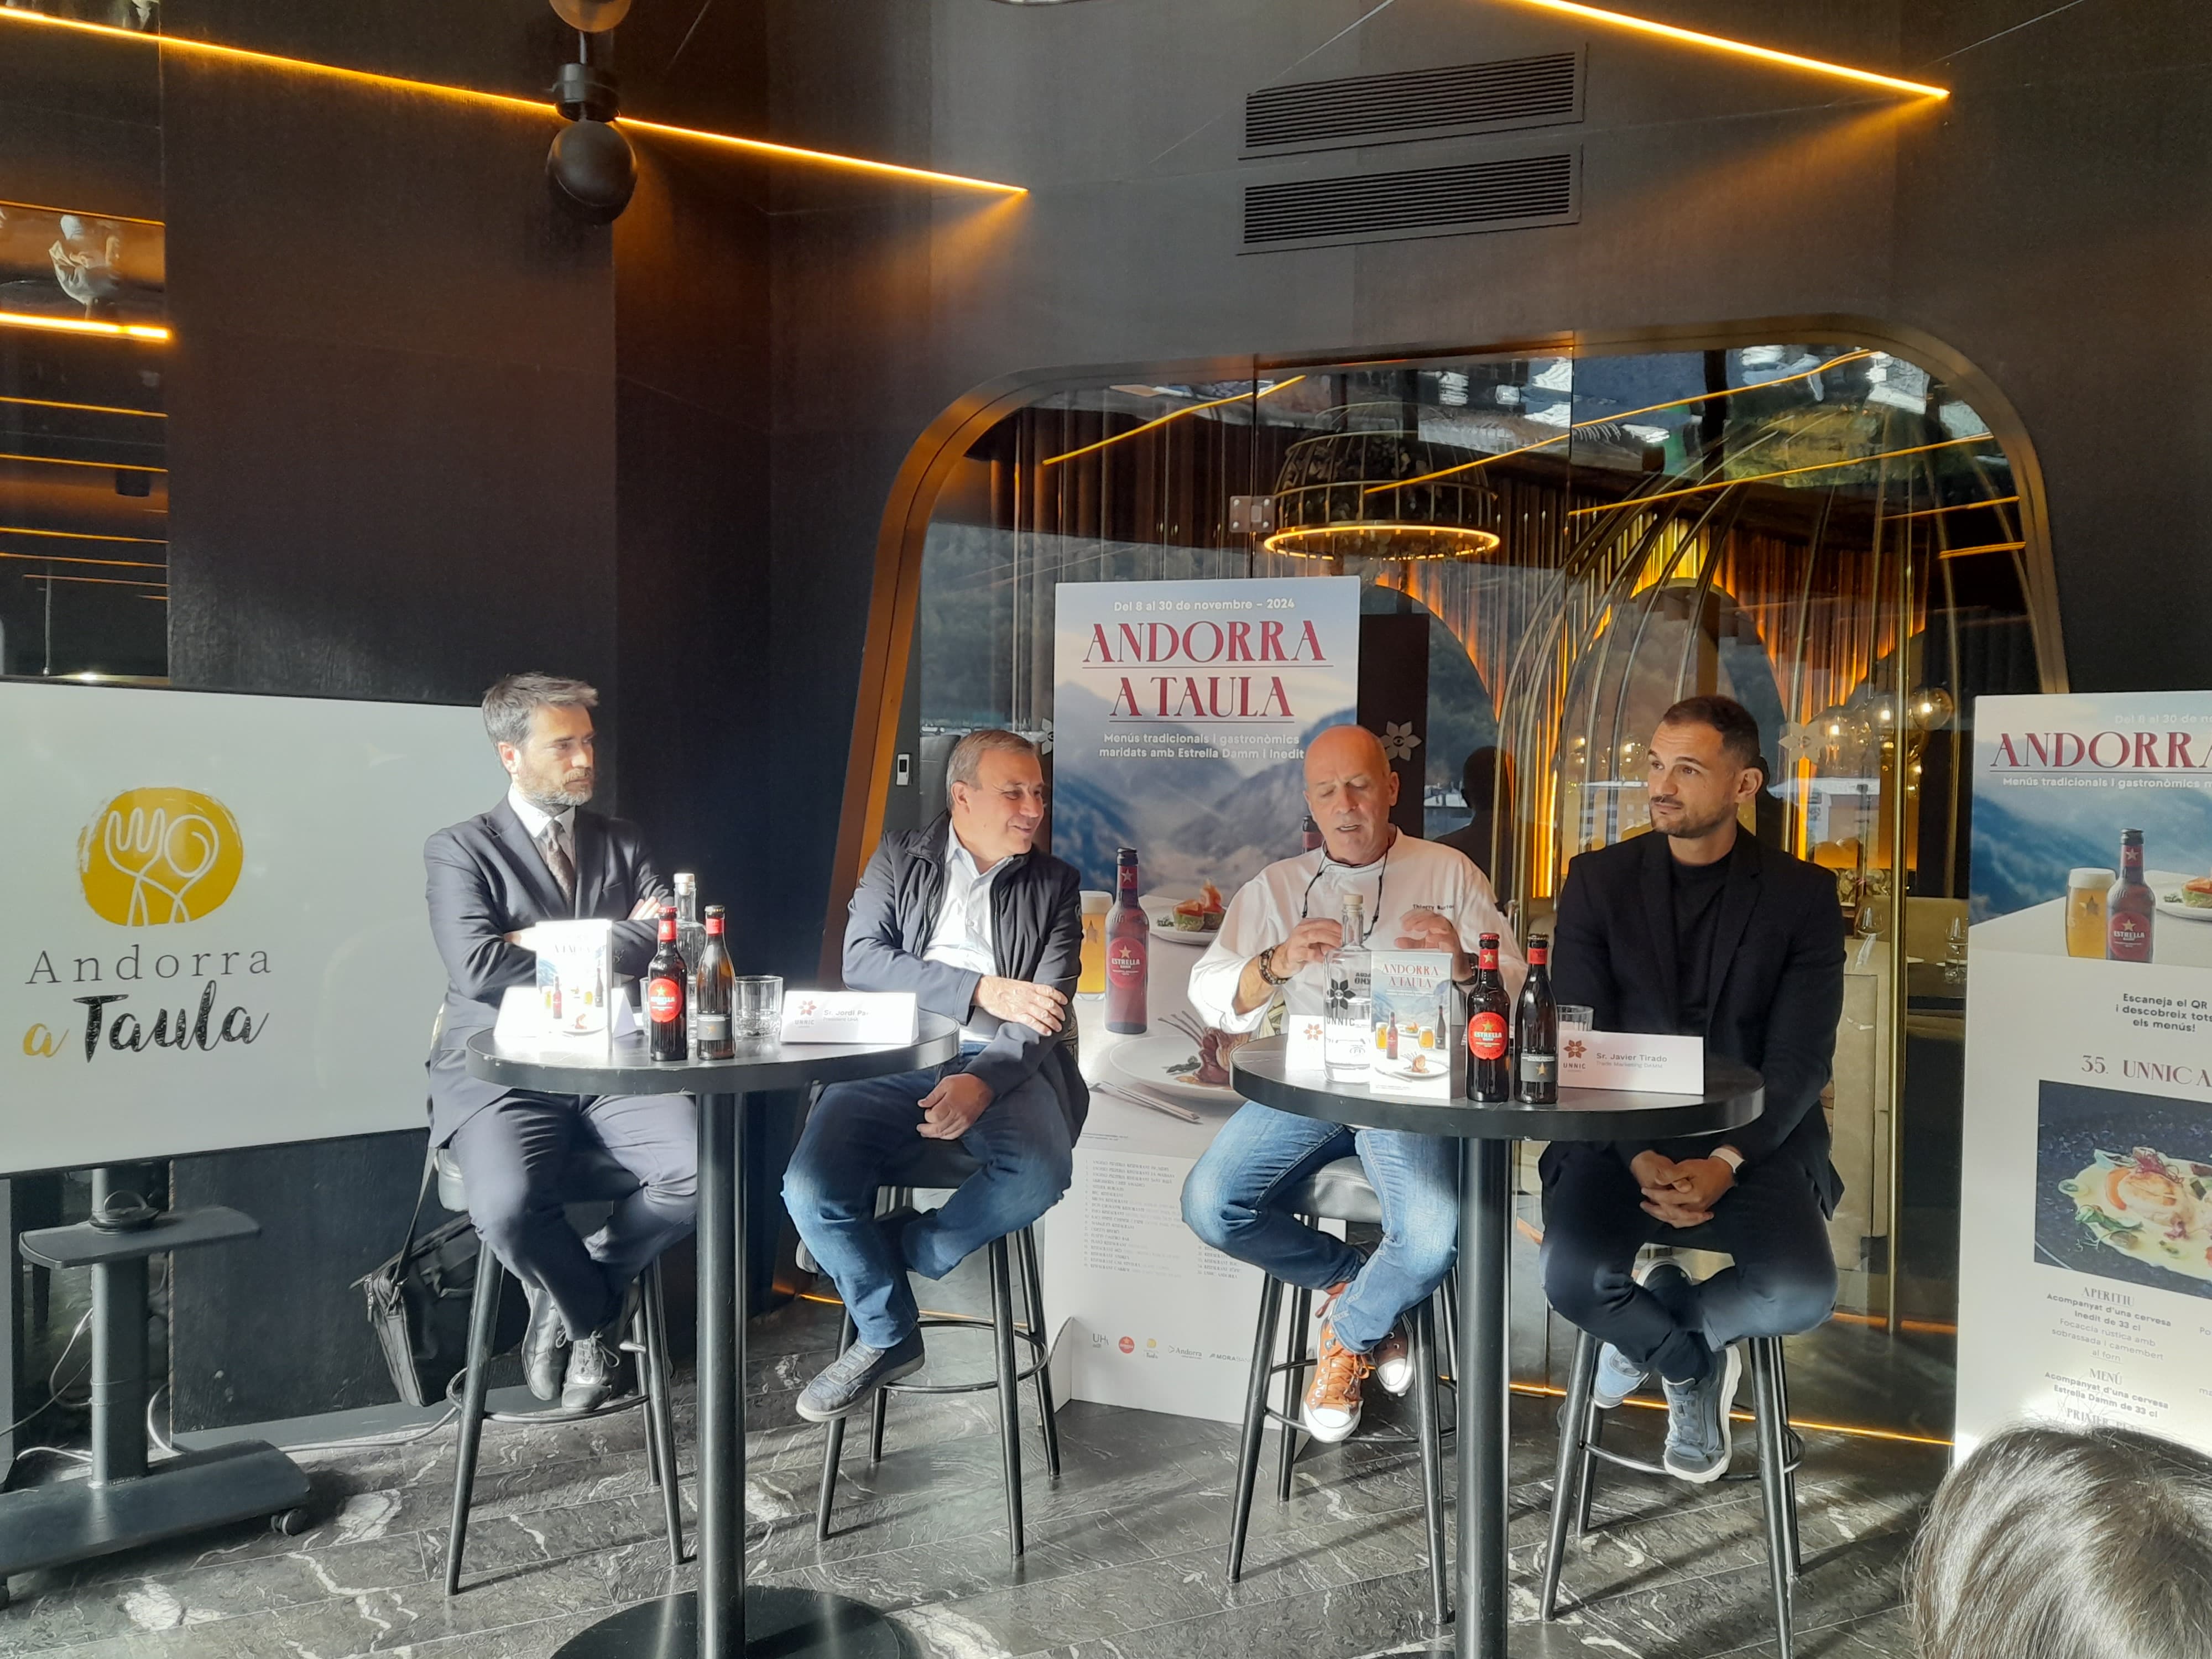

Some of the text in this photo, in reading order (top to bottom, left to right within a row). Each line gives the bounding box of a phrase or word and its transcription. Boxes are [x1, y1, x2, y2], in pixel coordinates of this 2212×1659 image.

[1114, 602, 1131, 611] Del
[1136, 601, 1142, 611] 8
[1146, 600, 1155, 610] al
[1159, 601, 1172, 611] 30
[1176, 599, 1190, 610] de
[1194, 599, 1252, 610] novembre
[1266, 598, 1295, 609] 2024
[1083, 620, 1326, 662] ANDORRA
[1109, 676, 1294, 718] A TAULA
[2115, 715, 2133, 724] Del
[2163, 714, 2177, 723] 30
[2182, 714, 2197, 723] de
[1104, 733, 1140, 744] Menús
[1143, 733, 1209, 744] tradicionals
[1219, 733, 1300, 747] gastronòmics
[1099, 747, 1147, 758] maridats
[1150, 748, 1175, 758] amb
[1178, 748, 1218, 758] Estrella
[1222, 749, 1259, 759] Damm
[1270, 748, 1305, 759] Inedit
[2003, 777, 2038, 786] Menús
[2042, 777, 2107, 787] tradicionals
[2118, 778, 2200, 789] gastronòmics
[24, 945, 271, 984] Andorra
[1381, 964, 1438, 975] ANDORRA
[2124, 994, 2172, 1007] Escaneja
[2191, 1000, 2208, 1009] QR
[23, 980, 269, 1062] a Taula
[2122, 1005, 2187, 1020] descobreix
[2133, 1019, 2196, 1032] els menús!
[2081, 1287, 2135, 1307] APERITIU
[2047, 1293, 2171, 1327] Acompanyat d'una cervesa
[2075, 1310, 2101, 1322] Inedit
[2104, 1317, 2116, 1326] de
[2119, 1321, 2130, 1329] 33
[2060, 1318, 2098, 1333] Focaccia
[2135, 1337, 2156, 1347] amb
[2052, 1328, 2101, 1345] sobrassada
[2109, 1342, 2163, 1361] camembert
[2103, 1351, 2121, 1361] forn
[2089, 1368, 2123, 1385] MENÚ
[2044, 1371, 2100, 1391] Acompanyat
[2132, 1395, 2168, 1409] cervesa
[2054, 1385, 2085, 1399] Estrella
[2089, 1394, 2117, 1407] Damm
[2120, 1403, 2132, 1411] de
[2135, 1406, 2146, 1415] 33
